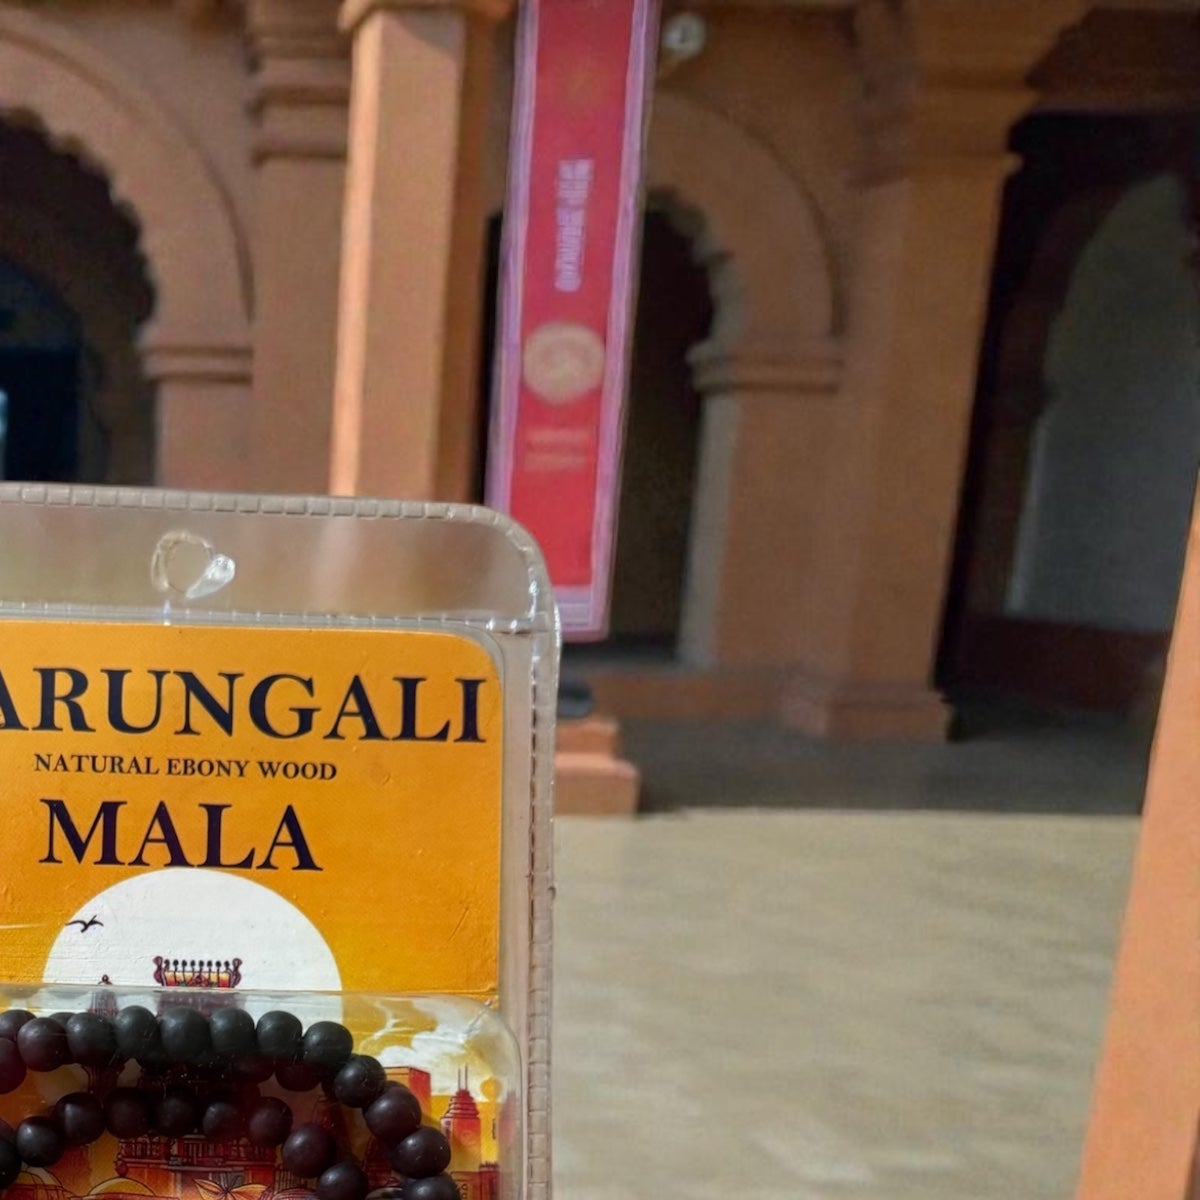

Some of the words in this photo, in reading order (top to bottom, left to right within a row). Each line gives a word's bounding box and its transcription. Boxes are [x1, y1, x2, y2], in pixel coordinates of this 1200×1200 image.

[34, 754, 159, 775] NATURAL
[166, 758, 250, 777] EBONY
[257, 761, 338, 780] WOOD
[38, 799, 324, 871] MALA
